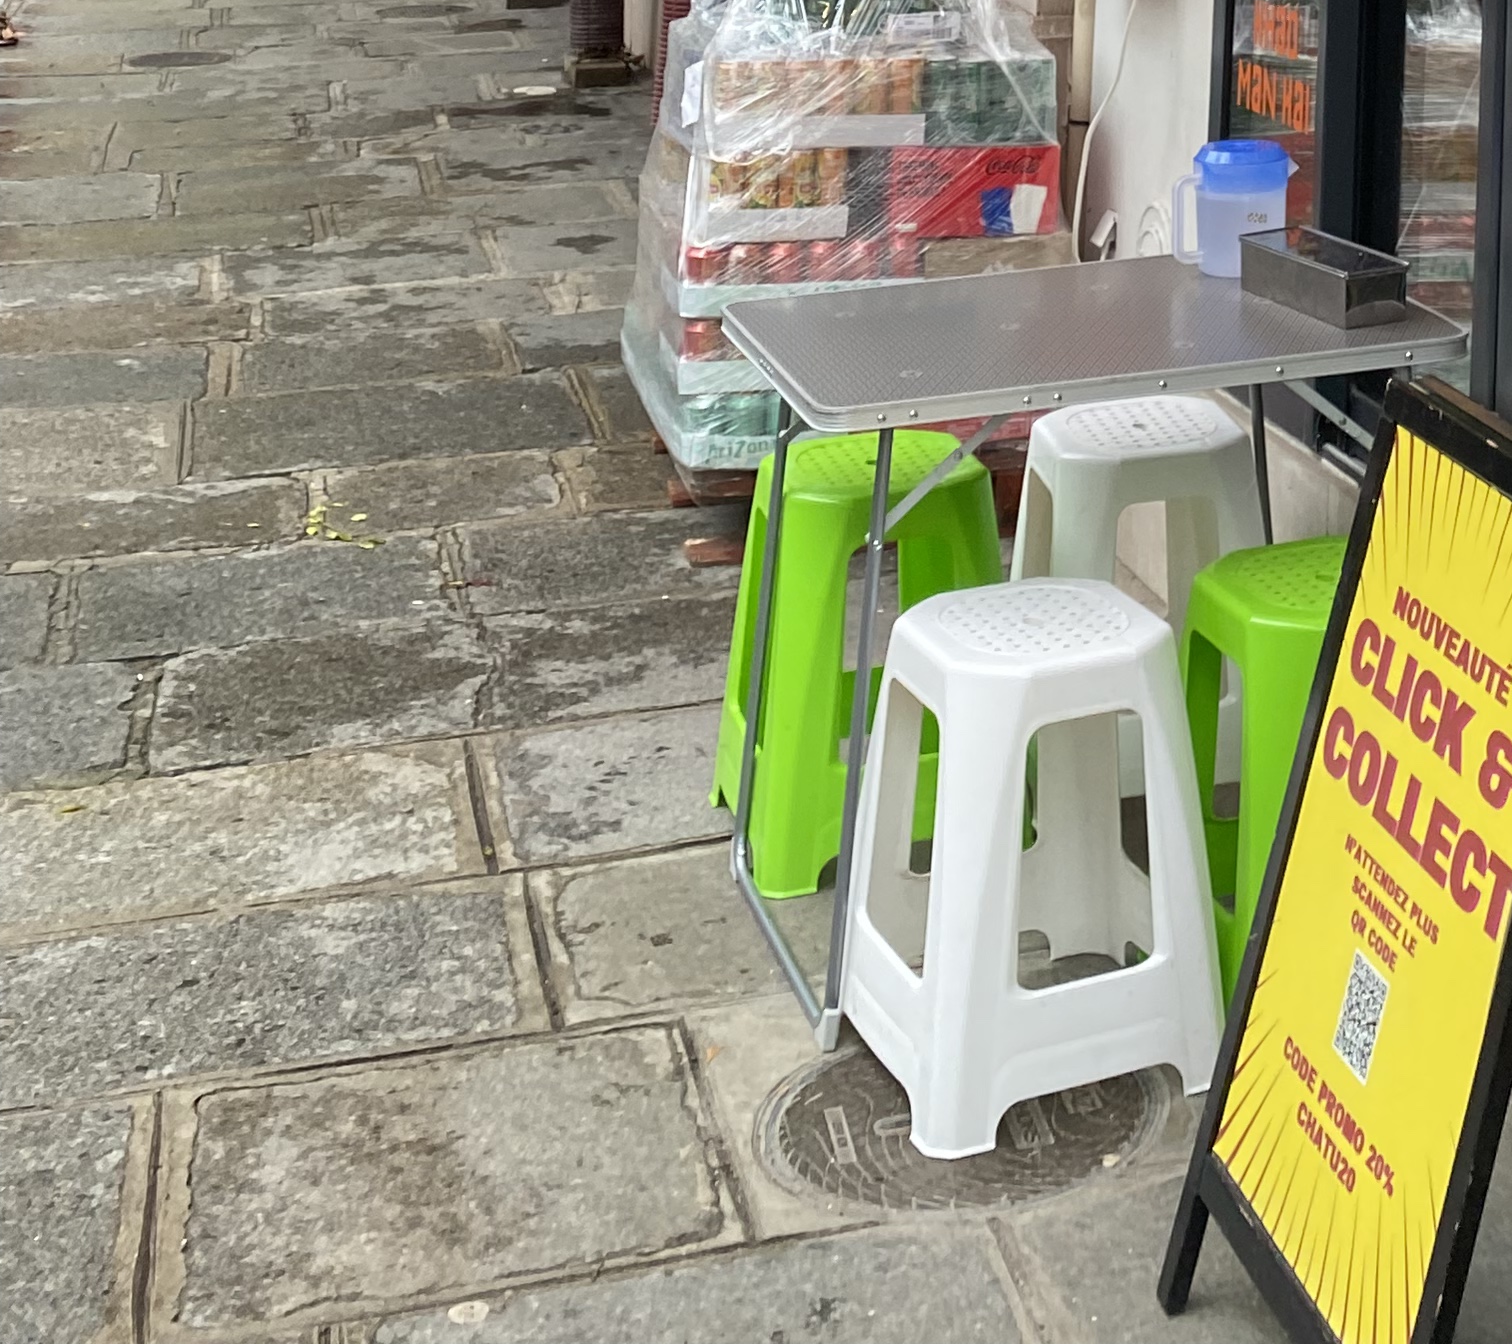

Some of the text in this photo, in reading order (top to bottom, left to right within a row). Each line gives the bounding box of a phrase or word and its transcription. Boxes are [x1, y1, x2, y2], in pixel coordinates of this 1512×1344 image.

[1351, 618, 1477, 776] CLICK
[1351, 909, 1398, 973] QR CODE
[1352, 876, 1417, 958] SCANNEZ LE
[1409, 901, 1439, 945] PLUS
[1284, 1036, 1395, 1198] CODE PROMO 20%
[1297, 1101, 1356, 1193] CHATU20
